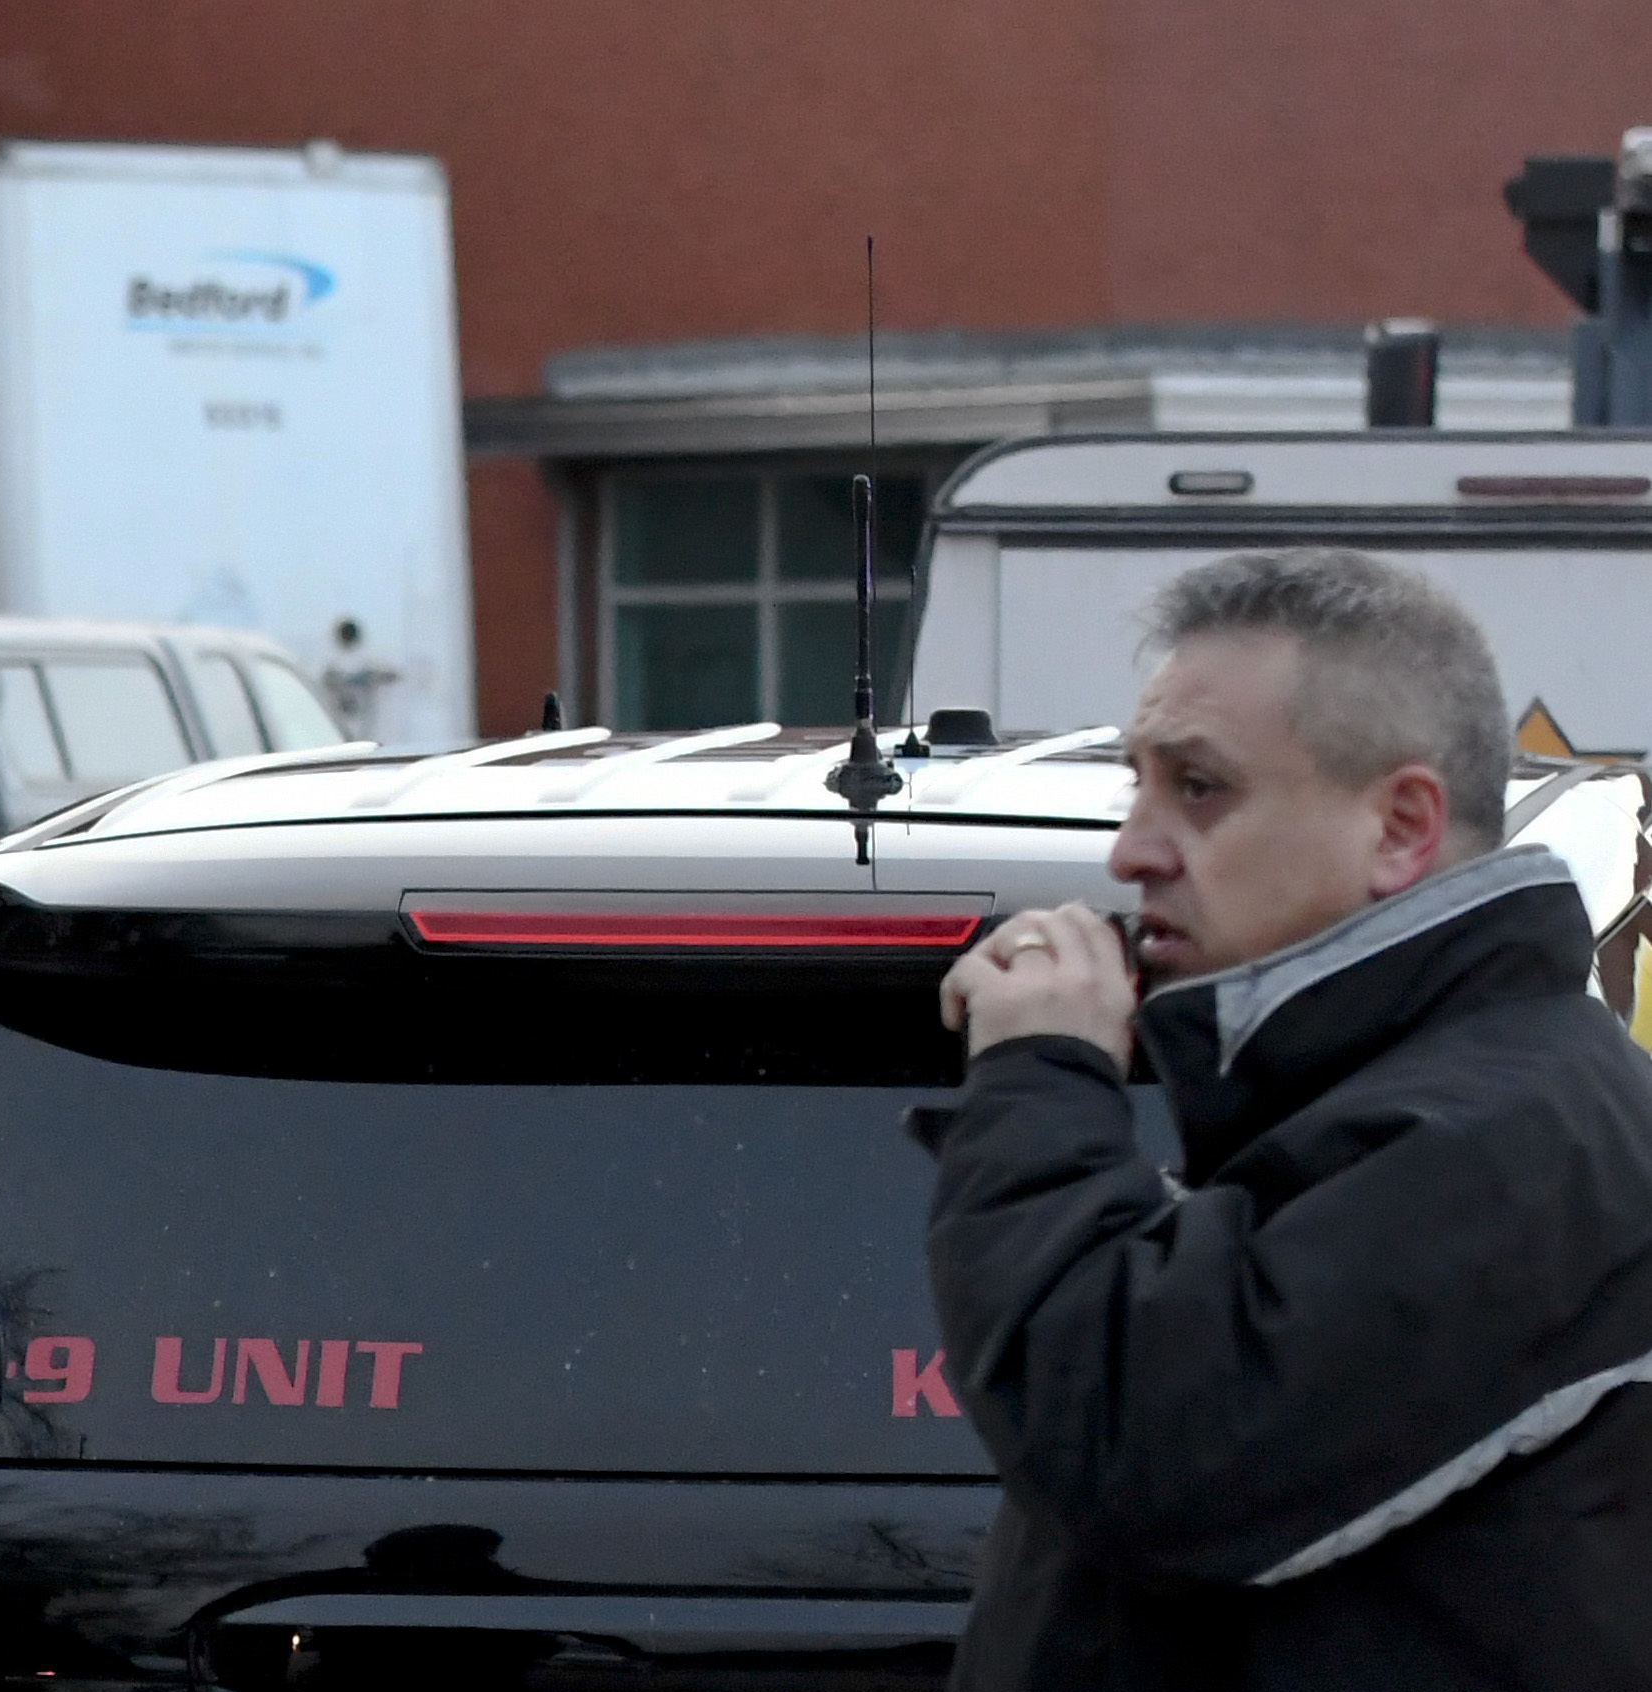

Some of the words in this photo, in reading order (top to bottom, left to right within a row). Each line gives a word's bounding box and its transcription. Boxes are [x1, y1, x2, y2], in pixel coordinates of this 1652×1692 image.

[128, 276, 290, 322] Bedford
[151, 1336, 424, 1409] UNIT
[891, 1348, 962, 1418] K
